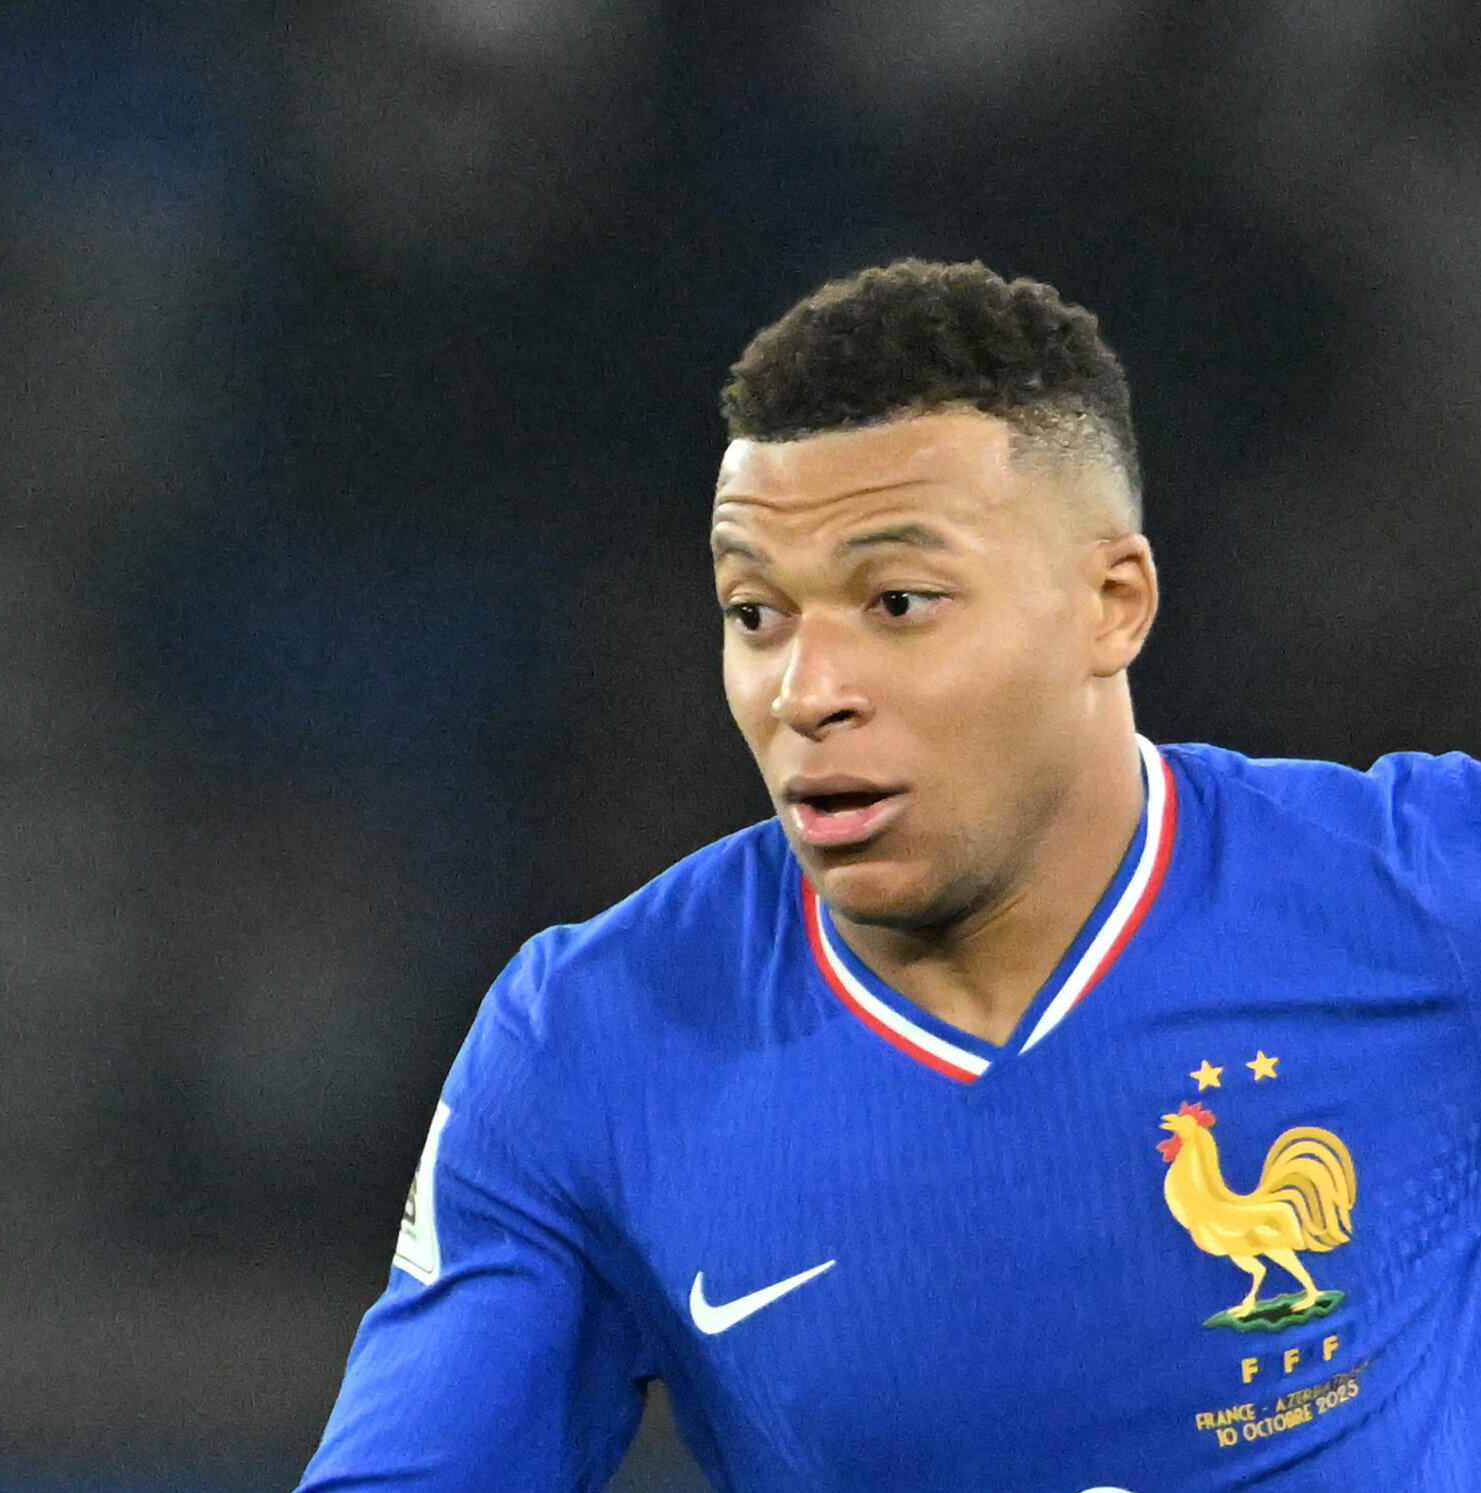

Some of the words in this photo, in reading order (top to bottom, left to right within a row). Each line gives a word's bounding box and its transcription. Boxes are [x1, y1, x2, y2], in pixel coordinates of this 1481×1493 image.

[1194, 1402, 1257, 1431] FRANCE
[1215, 1426, 1239, 1448] 10
[1315, 1378, 1360, 1415] 2025
